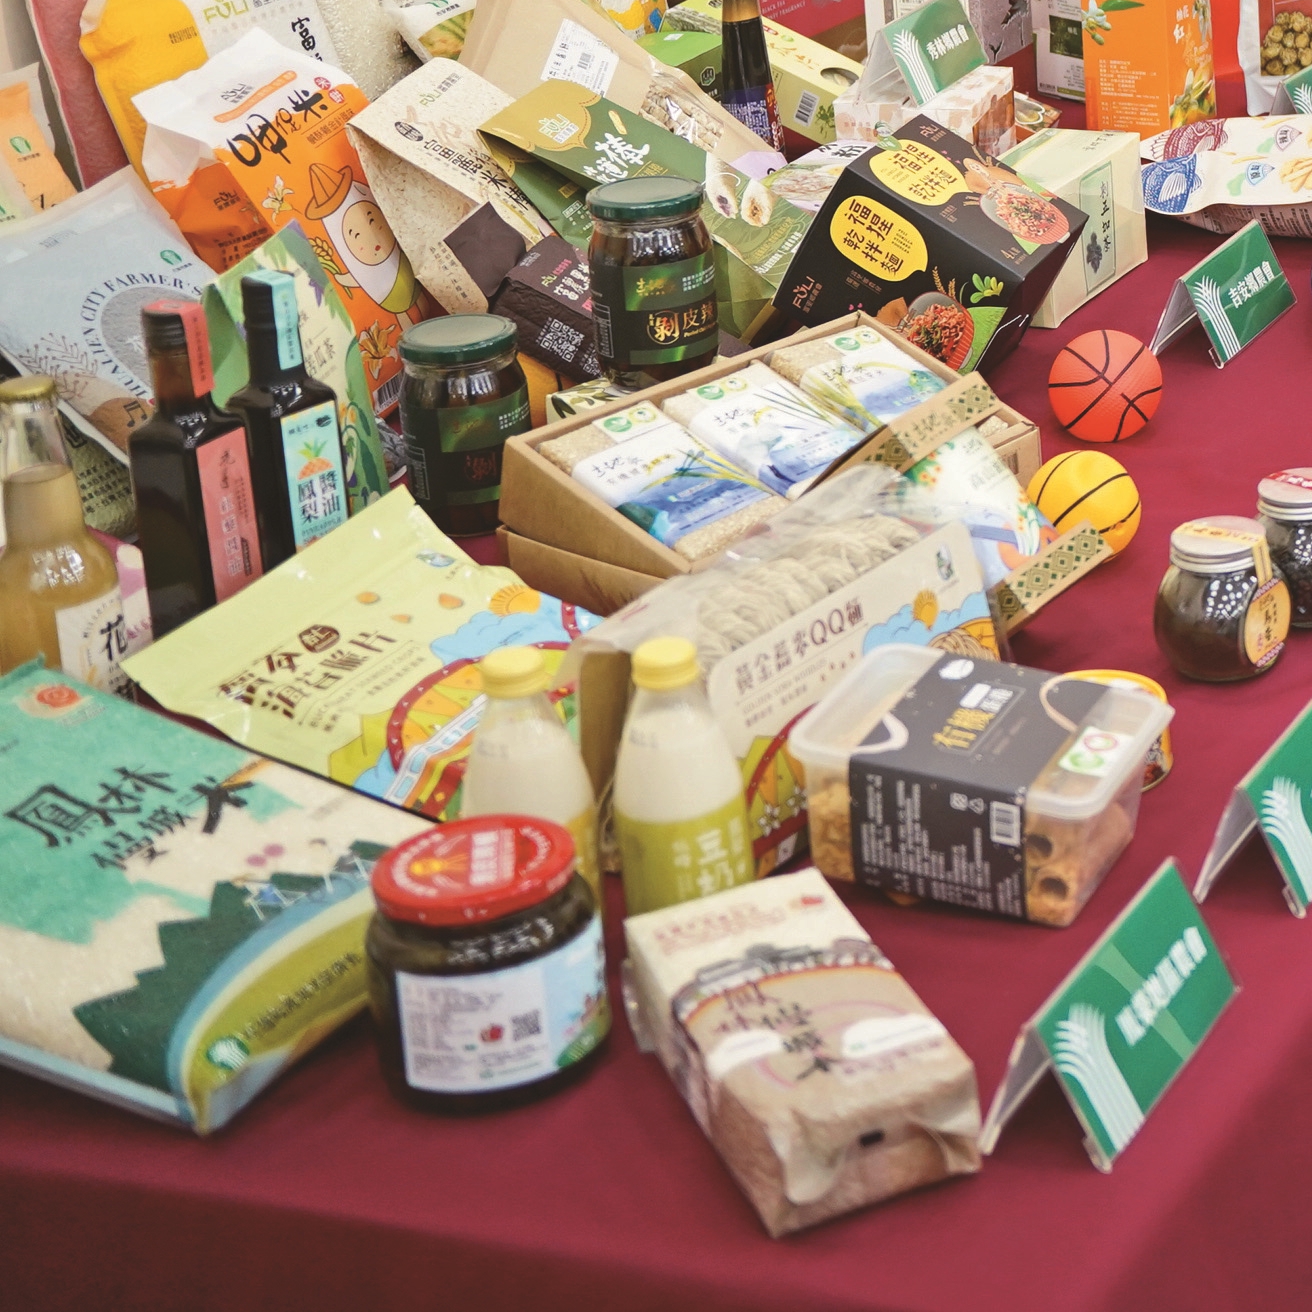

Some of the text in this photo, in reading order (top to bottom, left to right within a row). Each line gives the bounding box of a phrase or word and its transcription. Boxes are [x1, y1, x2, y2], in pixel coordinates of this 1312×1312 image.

[926, 23, 970, 61] 秀林鄉農會
[842, 228, 905, 278] 乾拌麵
[80, 290, 106, 322] CITY
[792, 275, 815, 309] FULI
[1228, 260, 1276, 309] 吉安鄉農會
[83, 327, 148, 397] HUALIEN
